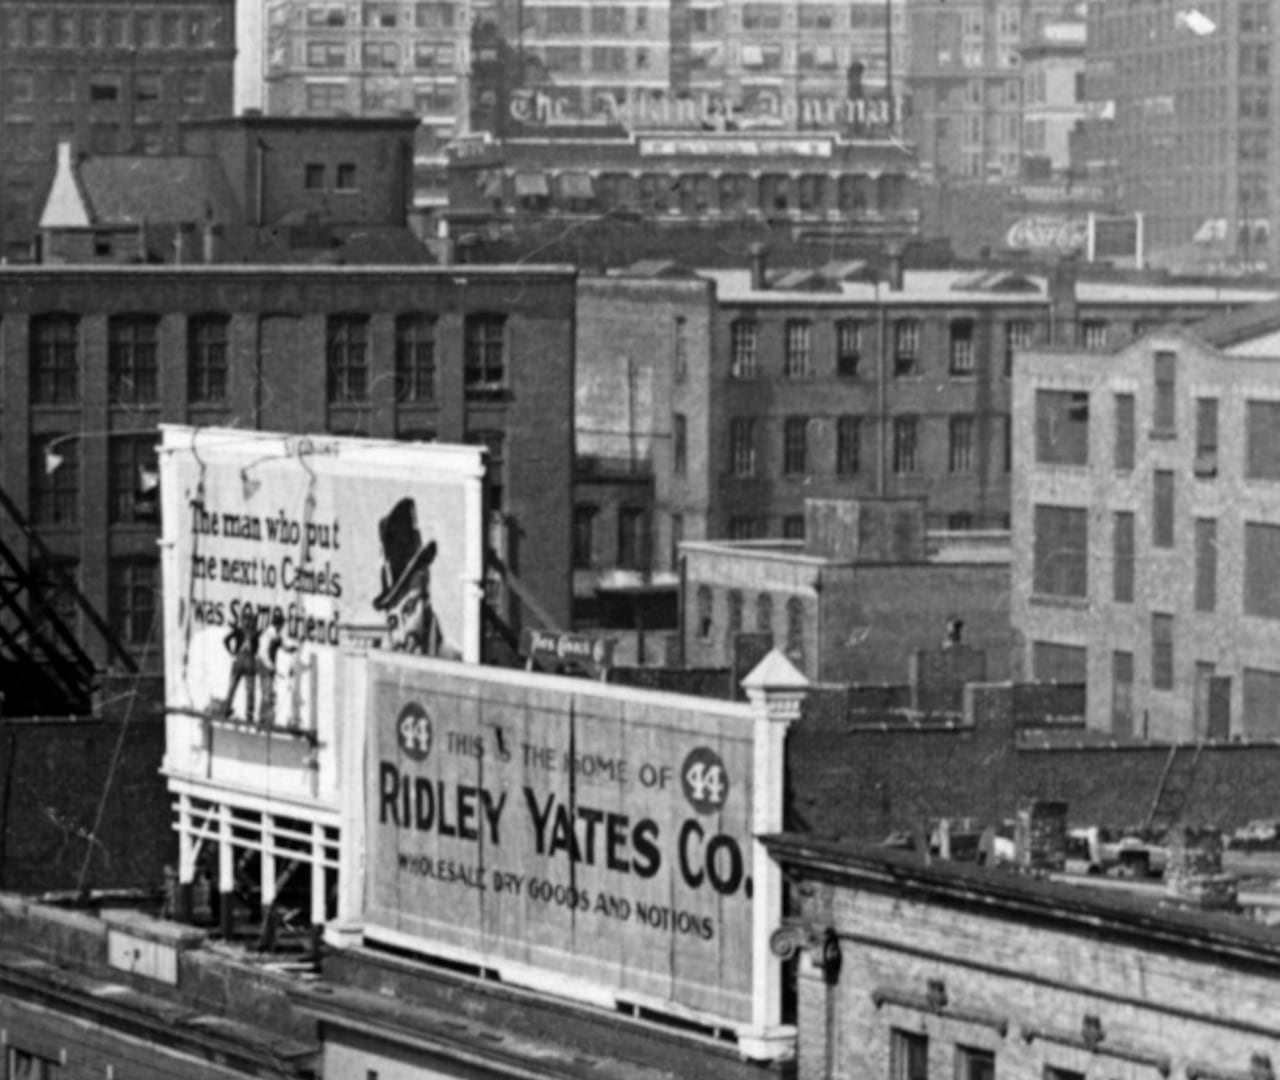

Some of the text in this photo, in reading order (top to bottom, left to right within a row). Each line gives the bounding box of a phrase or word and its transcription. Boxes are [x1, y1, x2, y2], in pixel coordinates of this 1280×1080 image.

[222, 511, 263, 542] man
[267, 509, 301, 546] who
[303, 517, 340, 562] put
[192, 553, 342, 599] me next to Camels
[193, 600, 225, 627] was
[287, 601, 340, 647] friend
[399, 713, 430, 751] 44
[446, 731, 485, 759] THIS
[522, 743, 557, 772] THE
[563, 748, 629, 784] HOME
[639, 763, 673, 791] OF
[684, 760, 726, 802] 44
[378, 760, 508, 846] RIDLEY
[522, 785, 662, 879] YATES
[396, 851, 715, 941] WHOLESALE DRY GOODS AND NOTIONS
